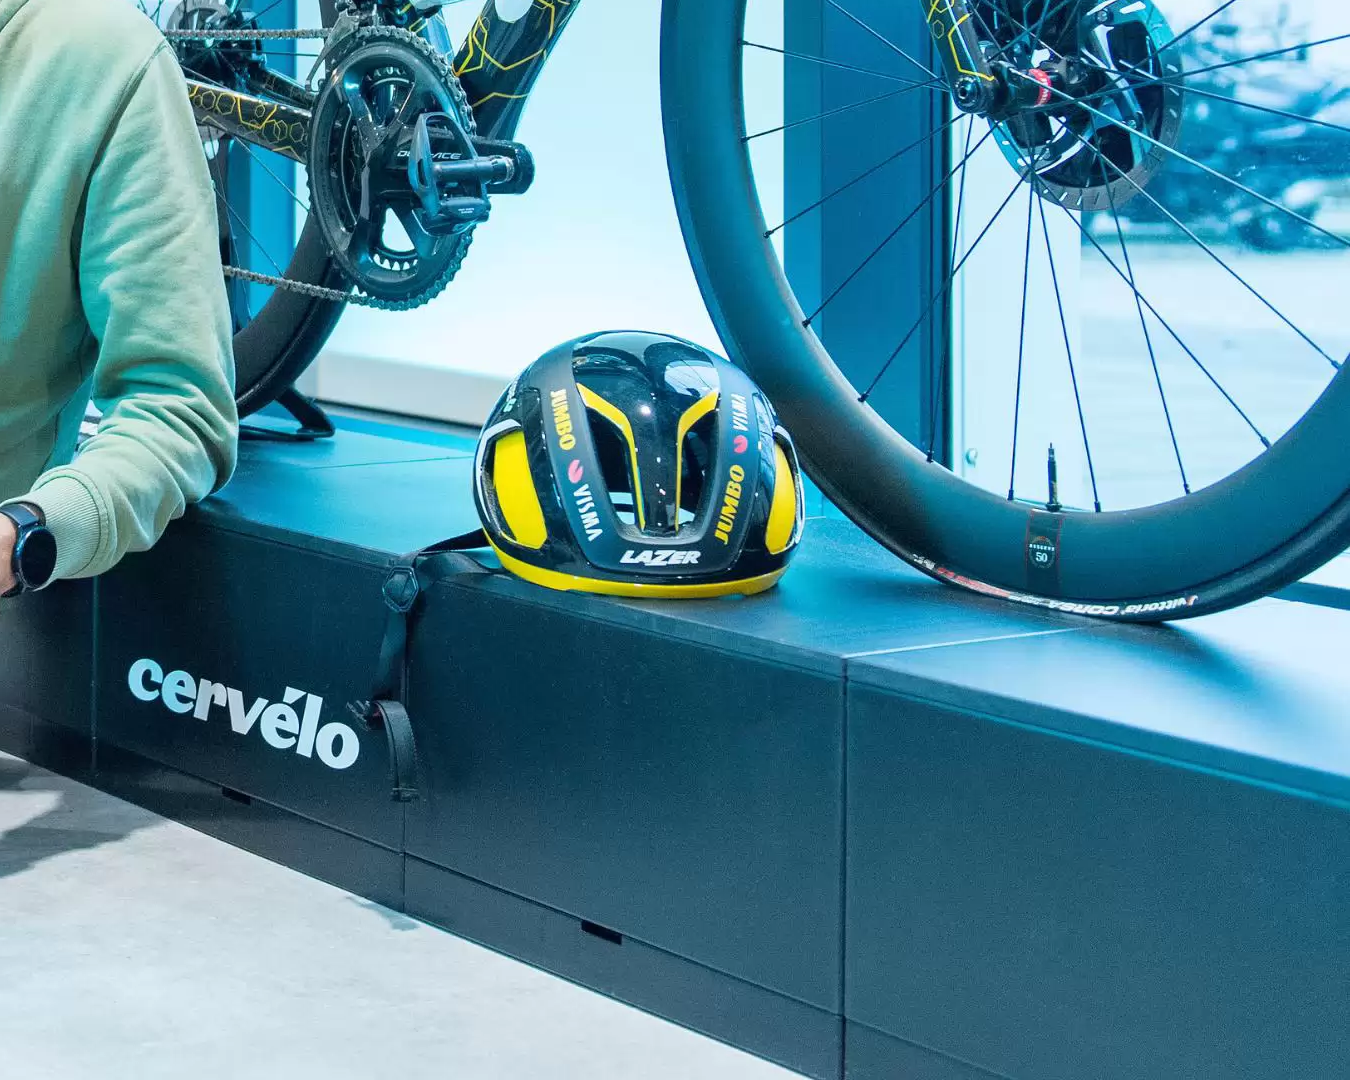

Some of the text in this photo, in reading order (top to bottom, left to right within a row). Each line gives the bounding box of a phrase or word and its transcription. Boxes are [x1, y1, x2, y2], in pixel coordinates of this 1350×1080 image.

[397, 150, 462, 160] D-ACE
[551, 388, 576, 450] JUMBO
[731, 393, 748, 432] VISMA
[573, 483, 603, 542] VISMA
[714, 464, 745, 546] JUMBO
[620, 550, 701, 566] LAZER
[1035, 551, 1048, 563] 50
[127, 658, 360, 770] cervélo
